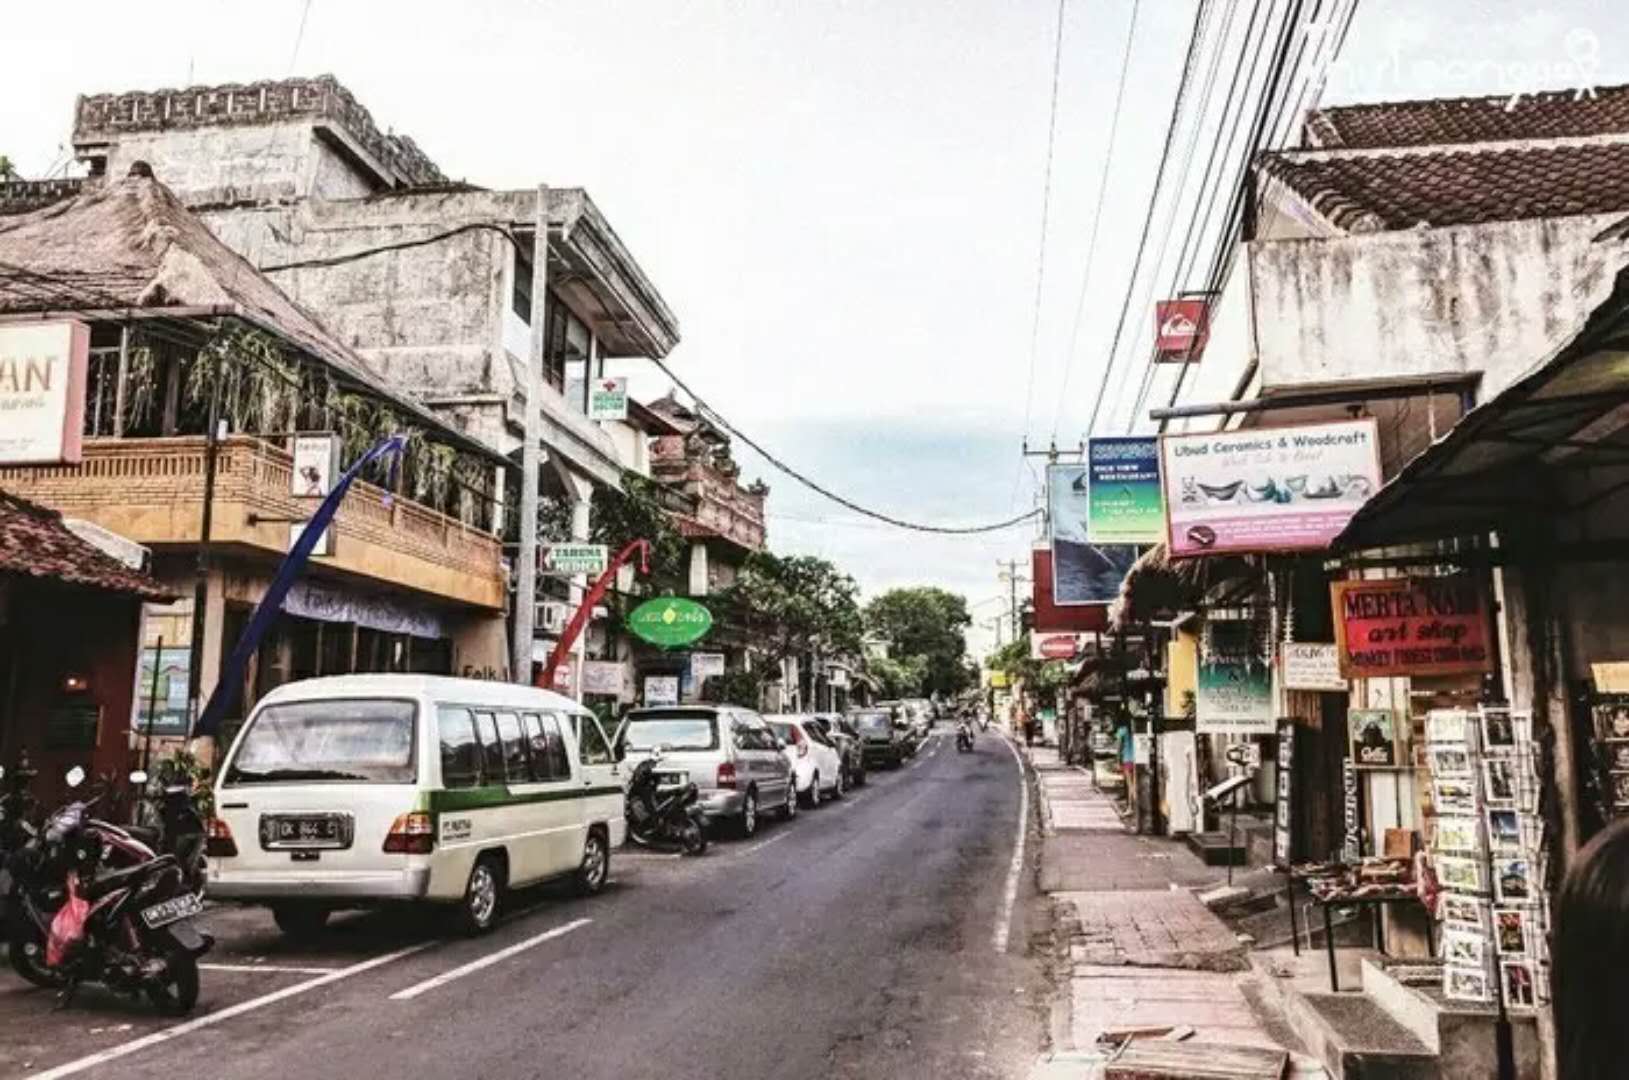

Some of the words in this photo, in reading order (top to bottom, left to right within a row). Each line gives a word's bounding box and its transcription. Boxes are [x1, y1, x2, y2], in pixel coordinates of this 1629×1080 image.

[1175, 443, 1208, 457] Ubud
[1213, 440, 1271, 453] Ceramics
[1278, 437, 1287, 448] &
[1292, 431, 1366, 447] Woodcraft
[1368, 622, 1407, 643] art
[1416, 619, 1468, 644] shop
